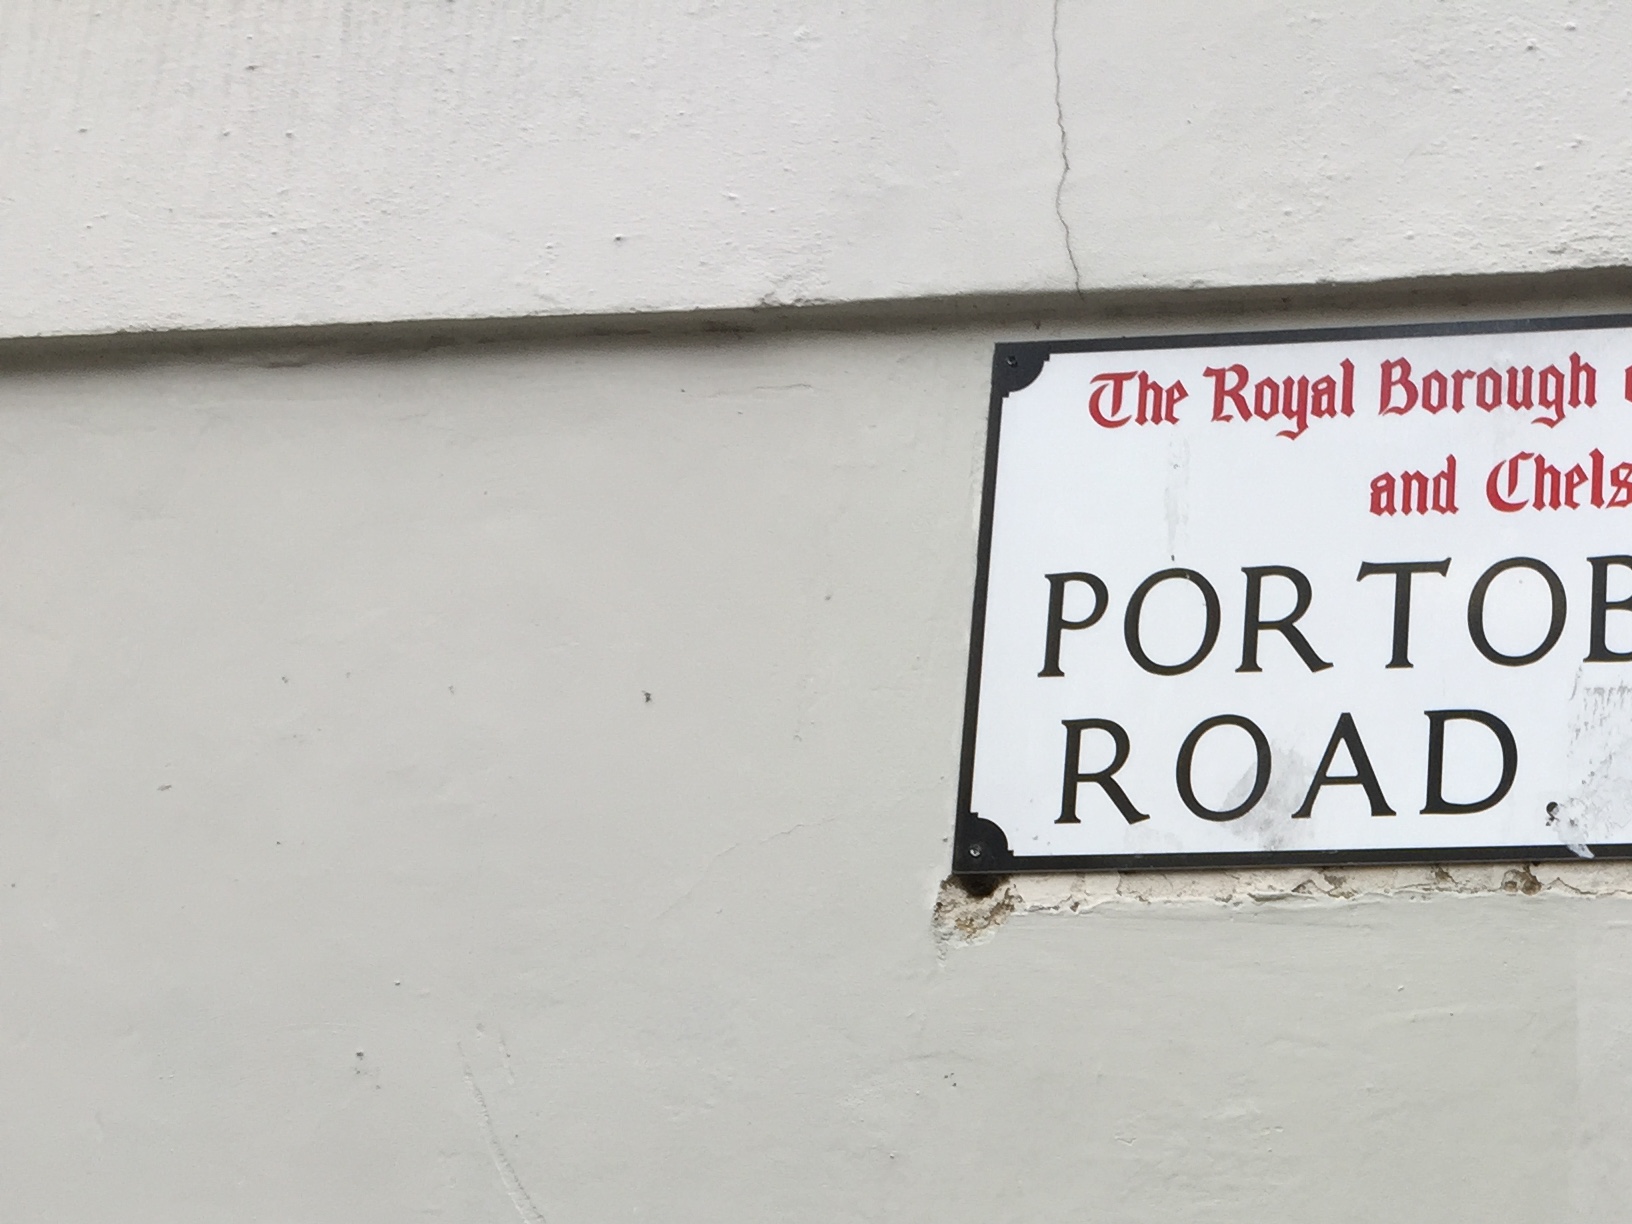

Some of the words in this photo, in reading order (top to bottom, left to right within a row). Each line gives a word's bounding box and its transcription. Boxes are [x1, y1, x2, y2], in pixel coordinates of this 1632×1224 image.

[1088, 371, 1188, 429] The
[1202, 358, 1356, 440] Royal
[1379, 351, 1598, 428] Borough
[1368, 453, 1460, 517] and
[1054, 709, 1518, 825] ROAD
